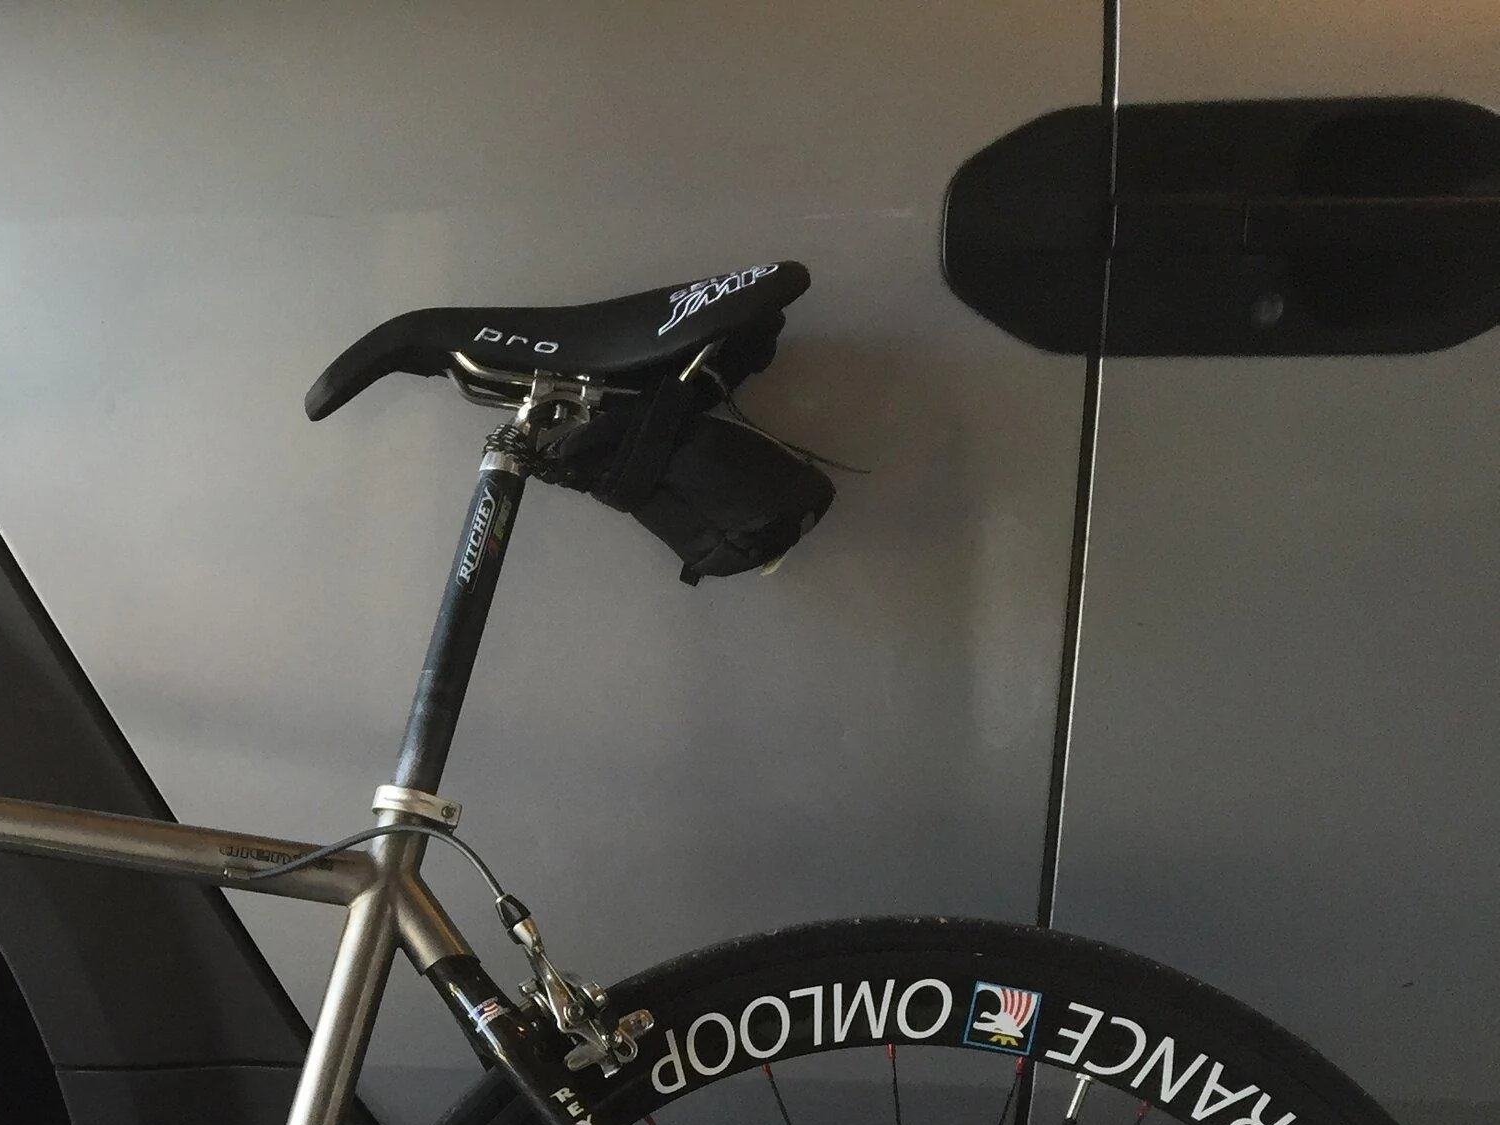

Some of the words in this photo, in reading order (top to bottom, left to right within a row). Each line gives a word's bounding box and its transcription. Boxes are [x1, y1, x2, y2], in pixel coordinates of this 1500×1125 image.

[474, 326, 560, 354] pro
[457, 488, 496, 585] RITCHEY
[650, 977, 953, 1096] OMLOOP
